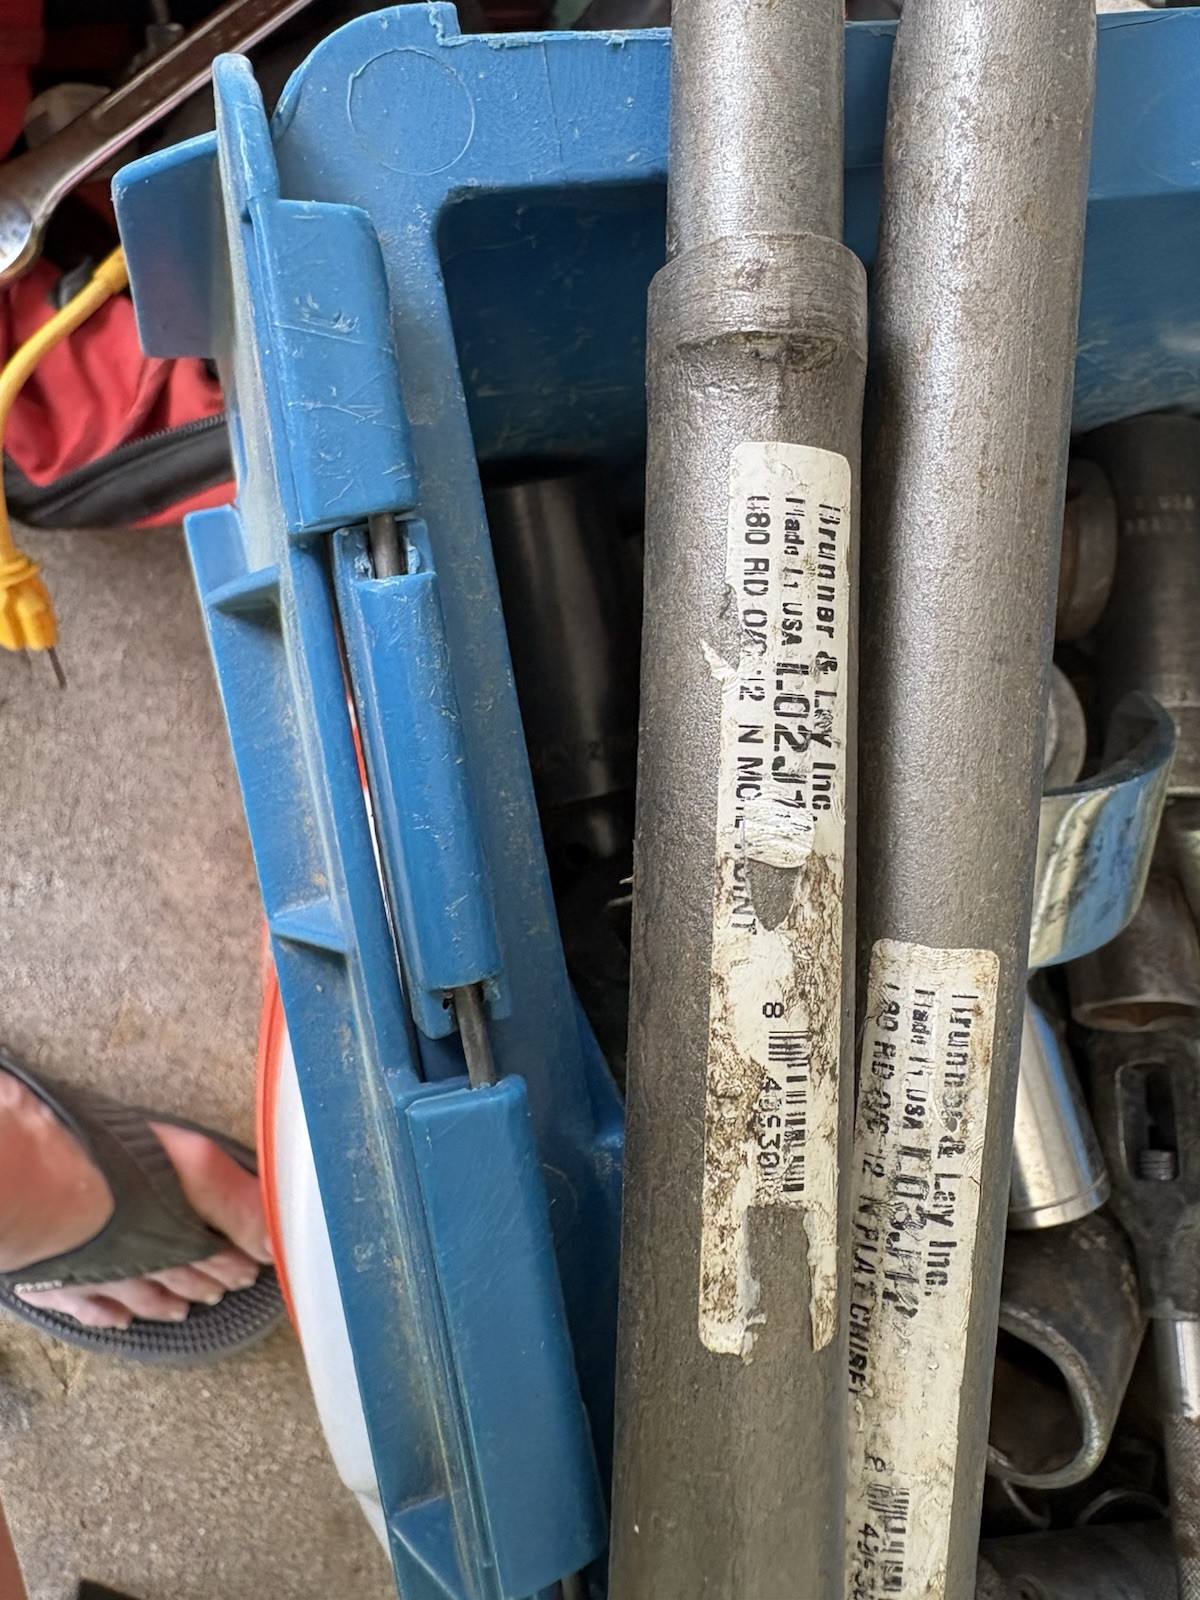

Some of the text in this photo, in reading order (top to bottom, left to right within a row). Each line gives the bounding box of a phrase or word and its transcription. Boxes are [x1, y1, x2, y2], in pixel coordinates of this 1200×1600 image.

[744, 558, 769, 596] RD
[782, 602, 803, 645] USA
[815, 651, 838, 675] &
[762, 1002, 784, 1018] 8
[903, 1088, 928, 1130] USA
[937, 1136, 966, 1159] &
[924, 1174, 964, 1228] Lay
[924, 1241, 957, 1296] Inc.
